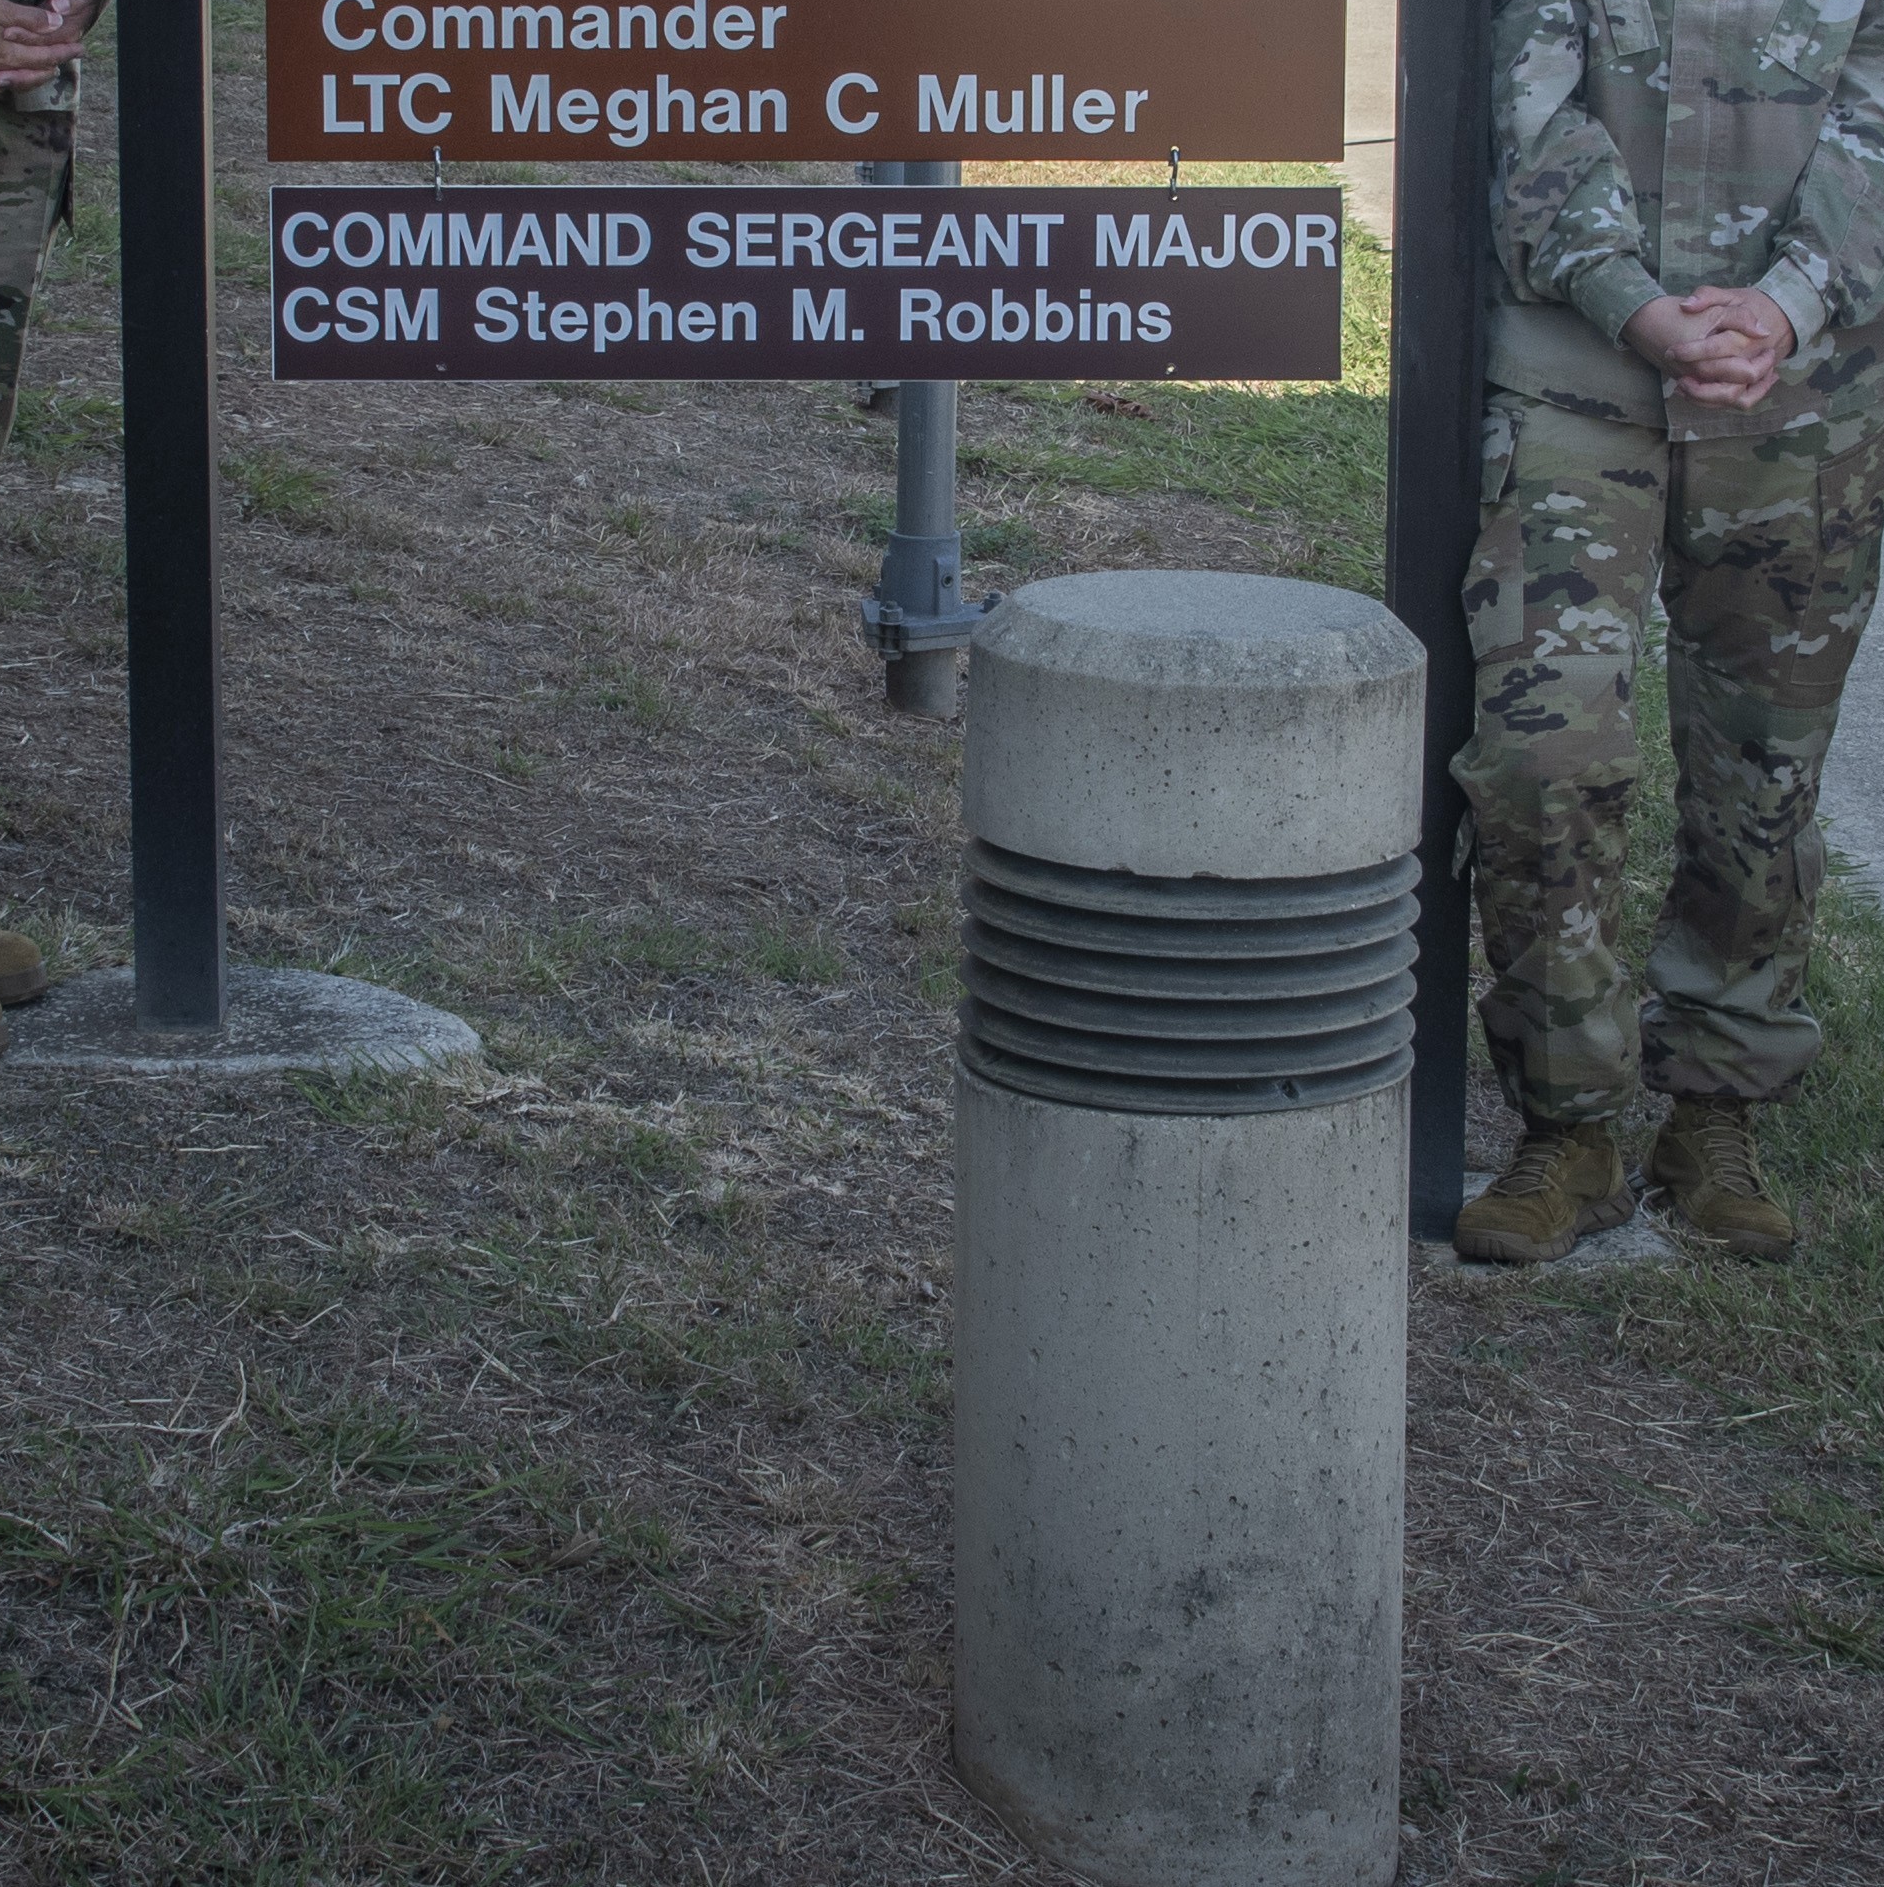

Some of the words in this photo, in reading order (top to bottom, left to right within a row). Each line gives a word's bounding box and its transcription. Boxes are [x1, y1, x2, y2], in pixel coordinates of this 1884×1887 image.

[322, 72, 452, 134] LTC
[490, 74, 787, 148] Meghan
[825, 72, 880, 135] C
[918, 73, 1149, 135] Muller
[281, 211, 651, 268] COMMAND
[685, 211, 1065, 269] SERGEANT
[1095, 211, 1338, 269] MAJOR
[282, 286, 439, 343] CSM
[473, 286, 757, 353] Stephen
[792, 288, 865, 342] M.
[899, 288, 1173, 343] Robbins
